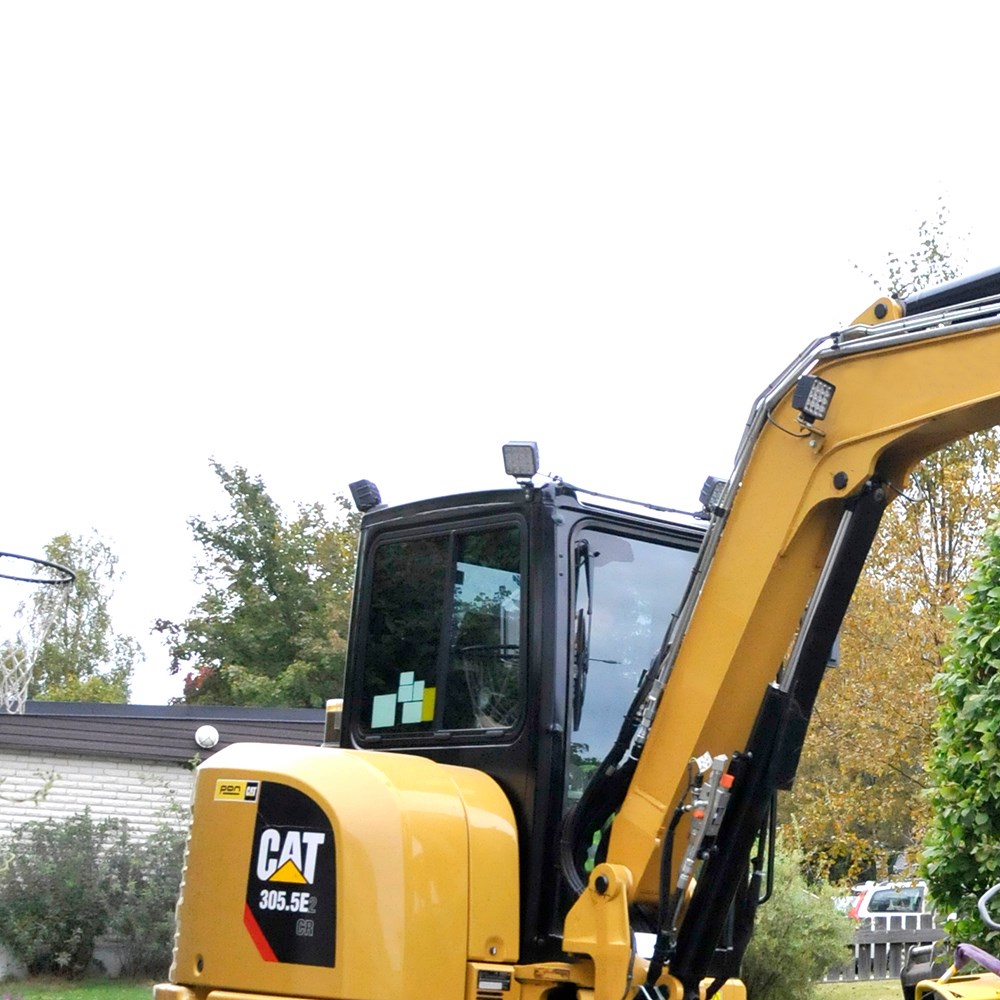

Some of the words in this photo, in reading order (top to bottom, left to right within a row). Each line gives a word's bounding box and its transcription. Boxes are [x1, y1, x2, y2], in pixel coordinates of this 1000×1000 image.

[220, 785, 241, 795] pon
[256, 828, 325, 885] CAT
[296, 918, 315, 937] CR
